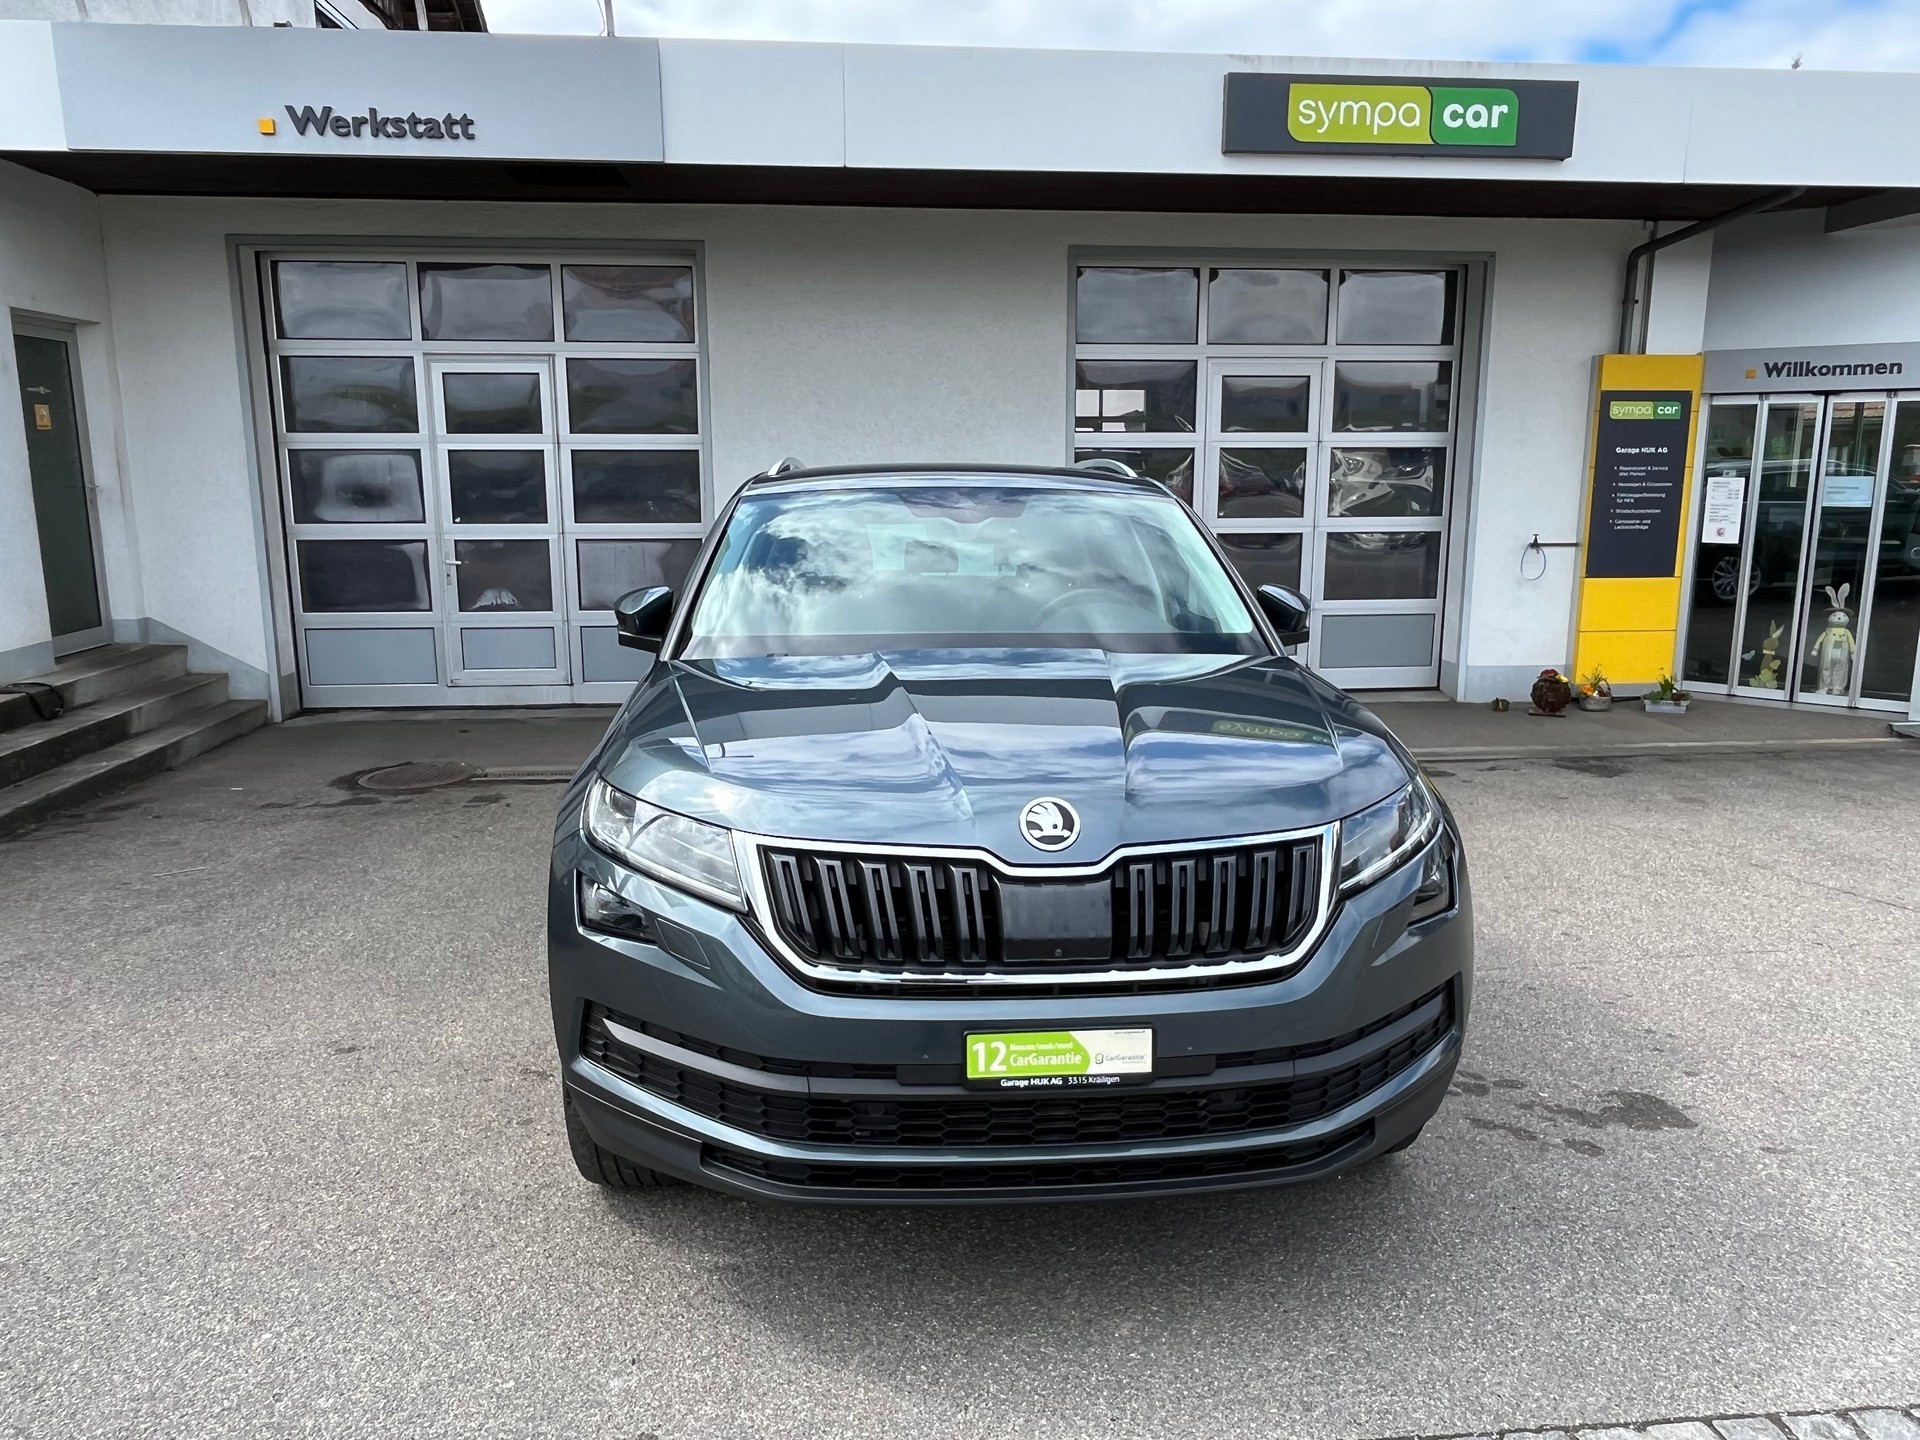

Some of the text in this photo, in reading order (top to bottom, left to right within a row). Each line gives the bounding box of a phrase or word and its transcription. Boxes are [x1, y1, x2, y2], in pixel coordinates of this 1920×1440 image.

[284, 104, 476, 140] Werkstatt
[1298, 99, 1509, 136] sympa car
[1764, 361, 1903, 378] Willkommen
[1612, 405, 1679, 417] sympa car
[972, 1041, 1007, 1073] 12
[1009, 1052, 1083, 1066] CarGarantie
[1001, 1079, 1029, 1088] Garage
[1050, 1077, 1062, 1085] AG
[1068, 1076, 1087, 1085] 3315
